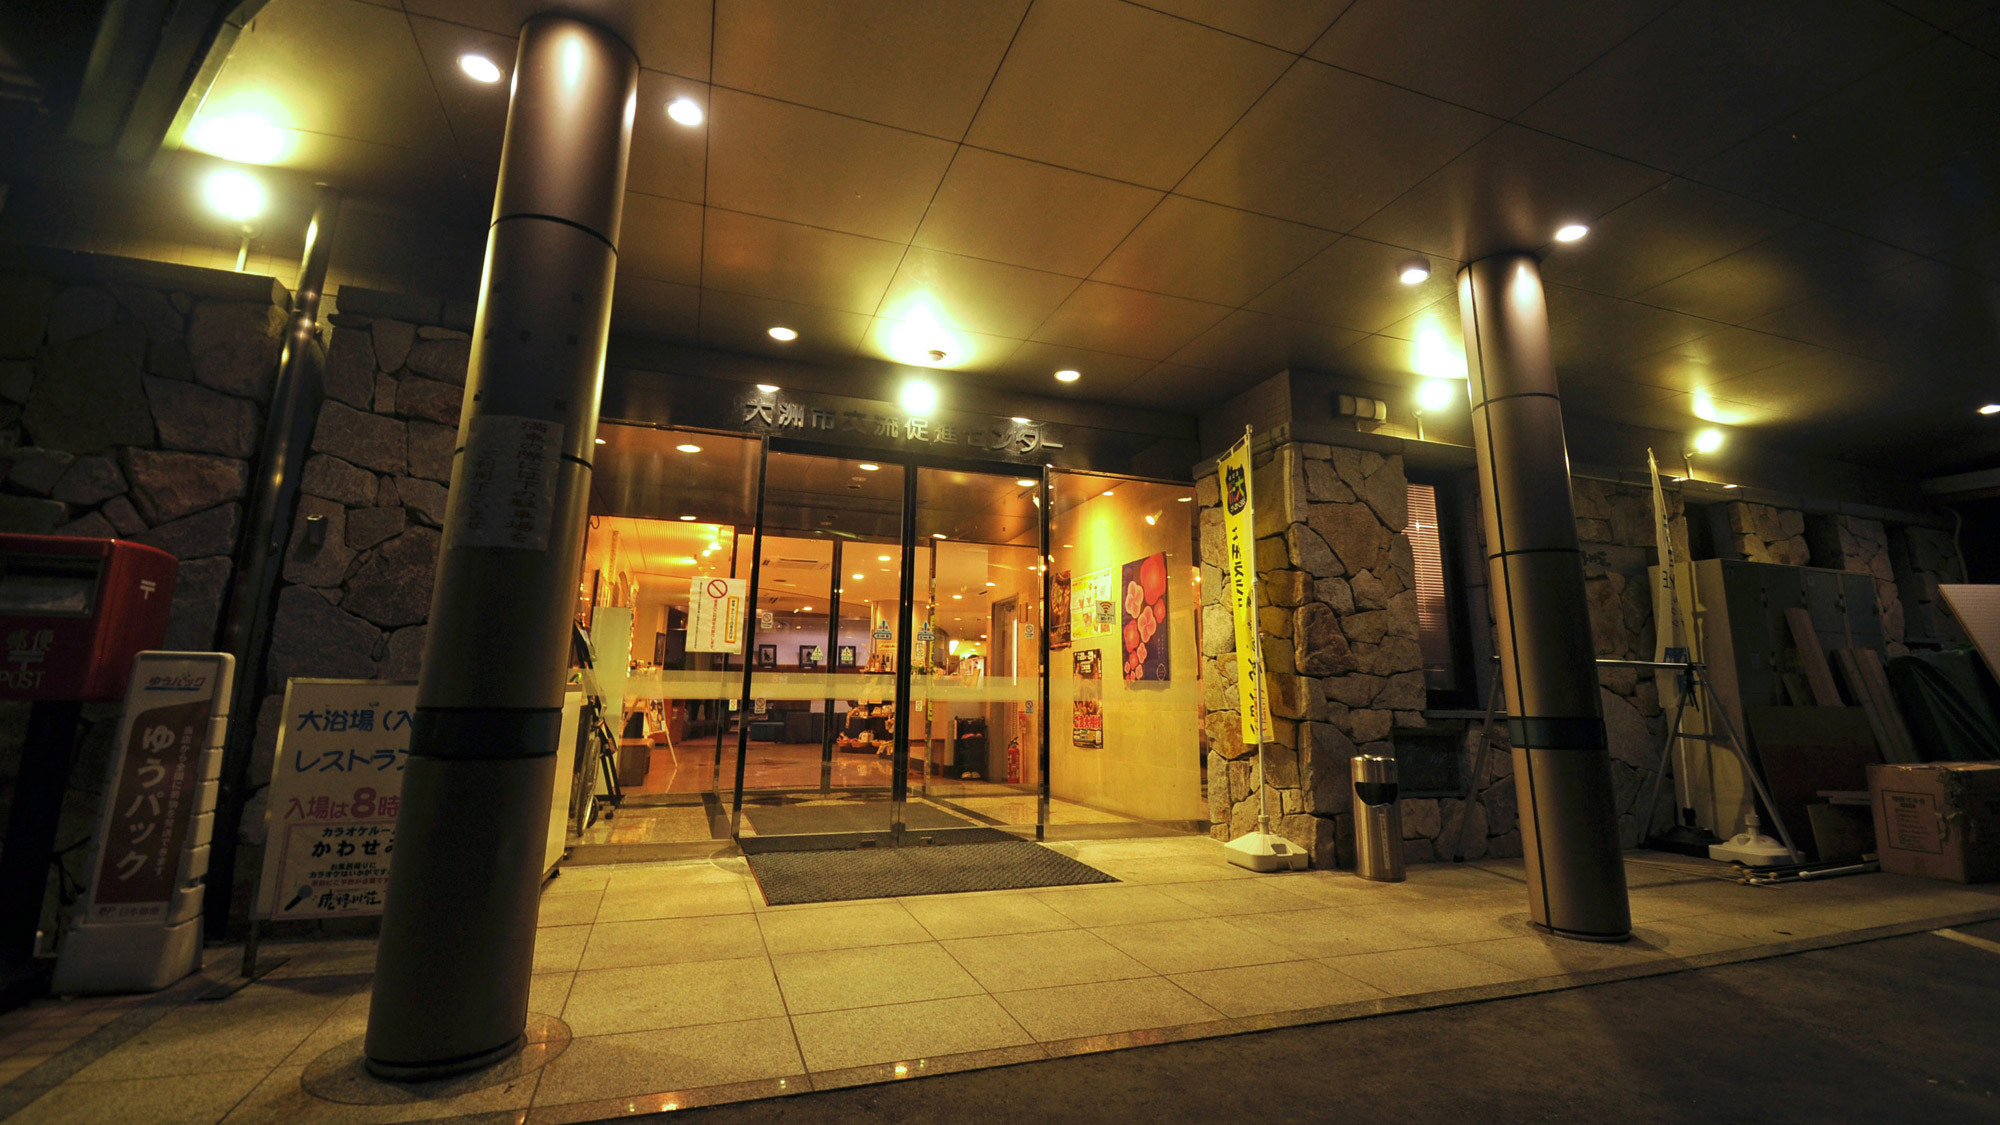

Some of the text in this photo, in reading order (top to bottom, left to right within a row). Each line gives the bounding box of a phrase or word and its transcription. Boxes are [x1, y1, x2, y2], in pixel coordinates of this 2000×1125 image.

[744, 400, 1064, 454] 大洲市交流促進センター
[7, 628, 55, 652] 郵便
[0, 669, 46, 690] POST
[148, 673, 208, 687] ゆうパック
[116, 723, 176, 882] ゆうパック
[284, 786, 400, 820] 入場は8時
[322, 826, 396, 838] カラオケルー
[309, 868, 391, 879] カラオケはいかがです
[119, 906, 160, 918] 日本郵便
